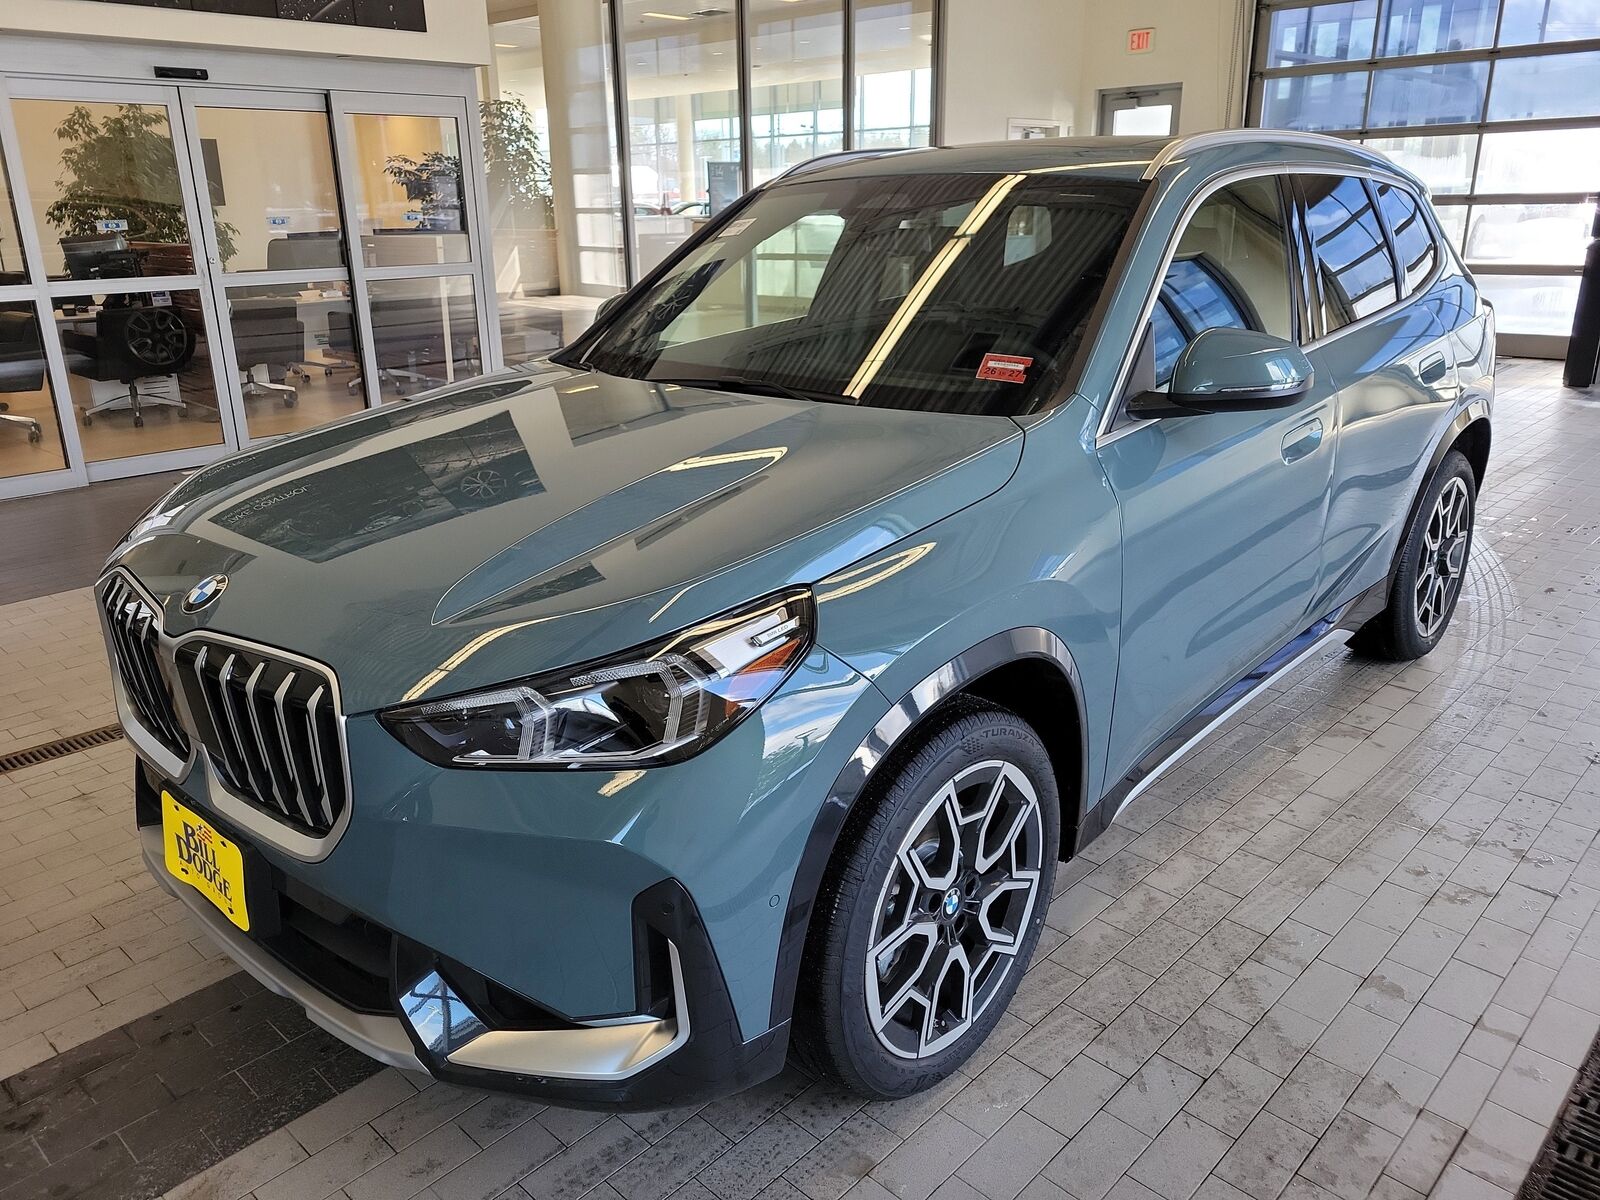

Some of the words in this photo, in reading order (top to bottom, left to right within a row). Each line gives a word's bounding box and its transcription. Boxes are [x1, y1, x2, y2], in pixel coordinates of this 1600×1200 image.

[1131, 32, 1150, 50] EXIT
[984, 367, 997, 375] 26
[1008, 370, 1022, 378] 27
[982, 727, 1036, 747] TURANZA
[182, 820, 220, 872] BILL
[175, 832, 232, 902] DODGE
